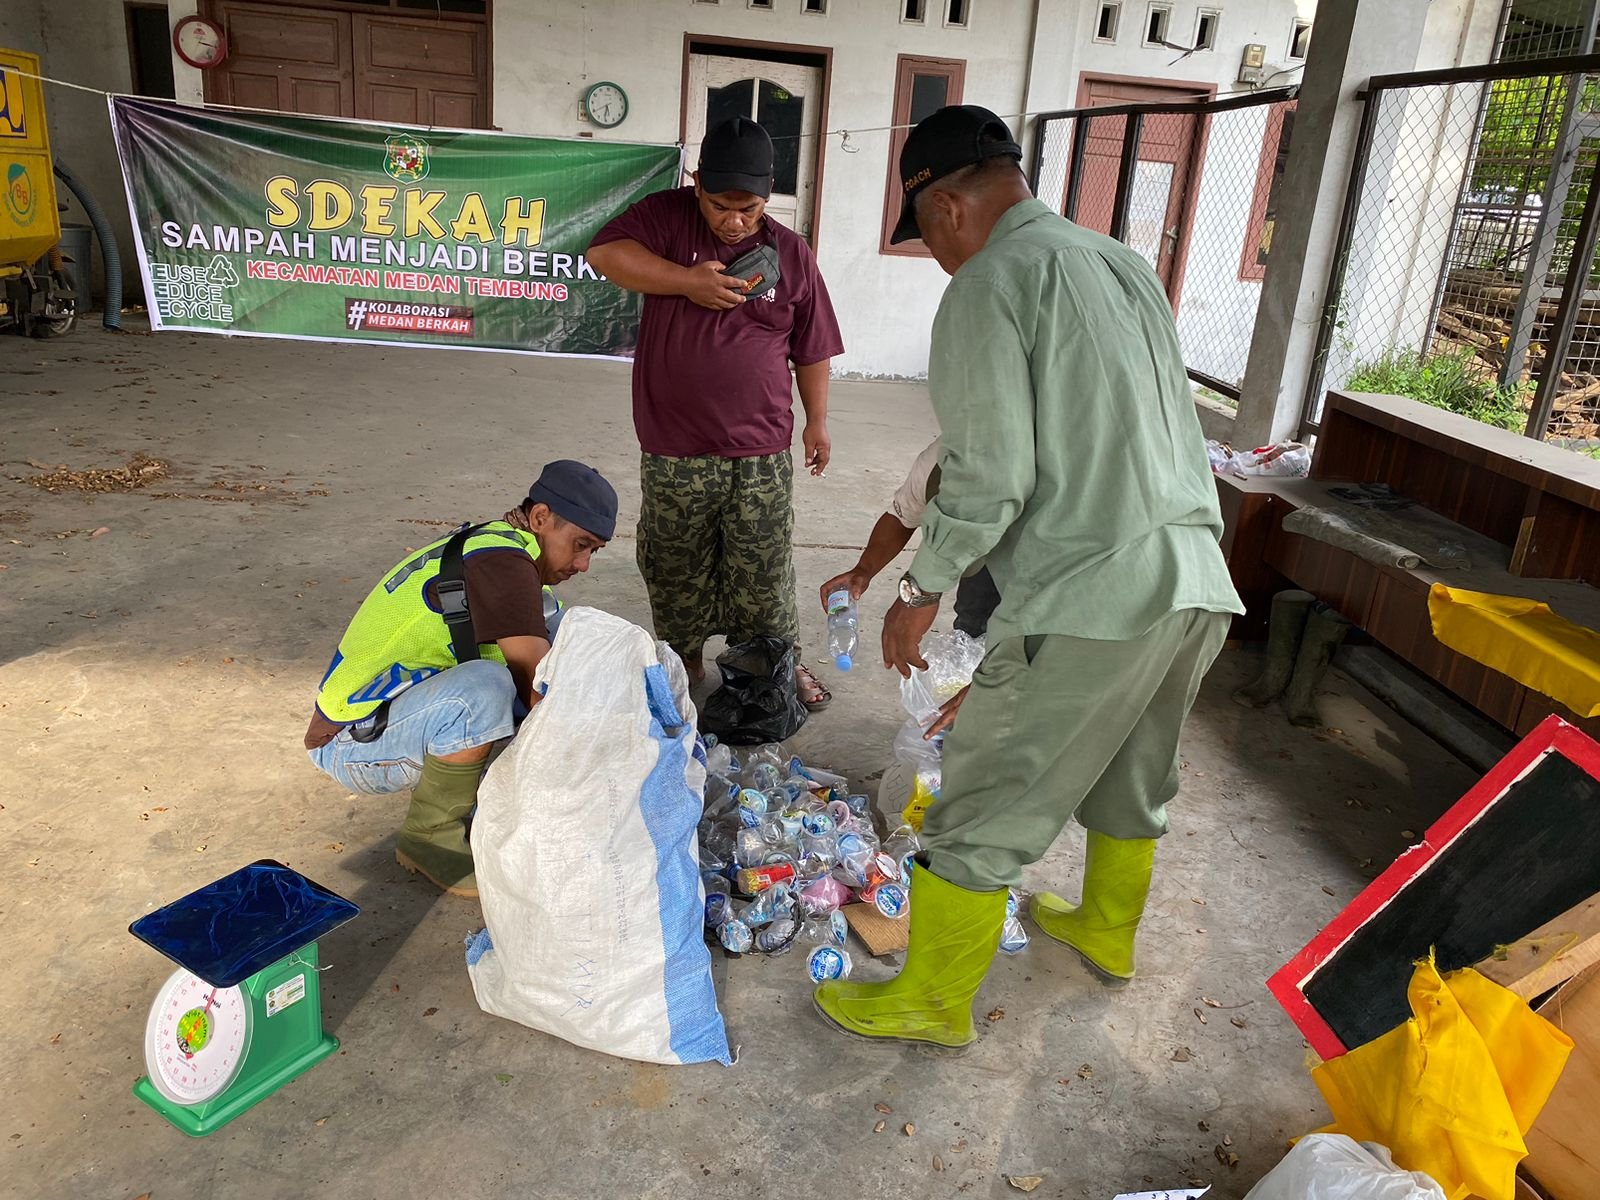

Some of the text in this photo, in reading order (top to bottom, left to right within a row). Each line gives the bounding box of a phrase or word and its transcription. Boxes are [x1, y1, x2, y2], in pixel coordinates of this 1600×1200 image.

[904, 167, 932, 192] COACH
[265, 175, 546, 248] SDEKAH
[161, 221, 607, 282] SAMPAH MENJADI BERK
[150, 263, 206, 284] EUSE
[247, 260, 569, 301] KECAMATAN MEDAN TEMBUNG
[153, 281, 223, 304] EDUCE
[156, 300, 234, 322] ECYCLE
[368, 315, 469, 332] MEDAN BERKAH
